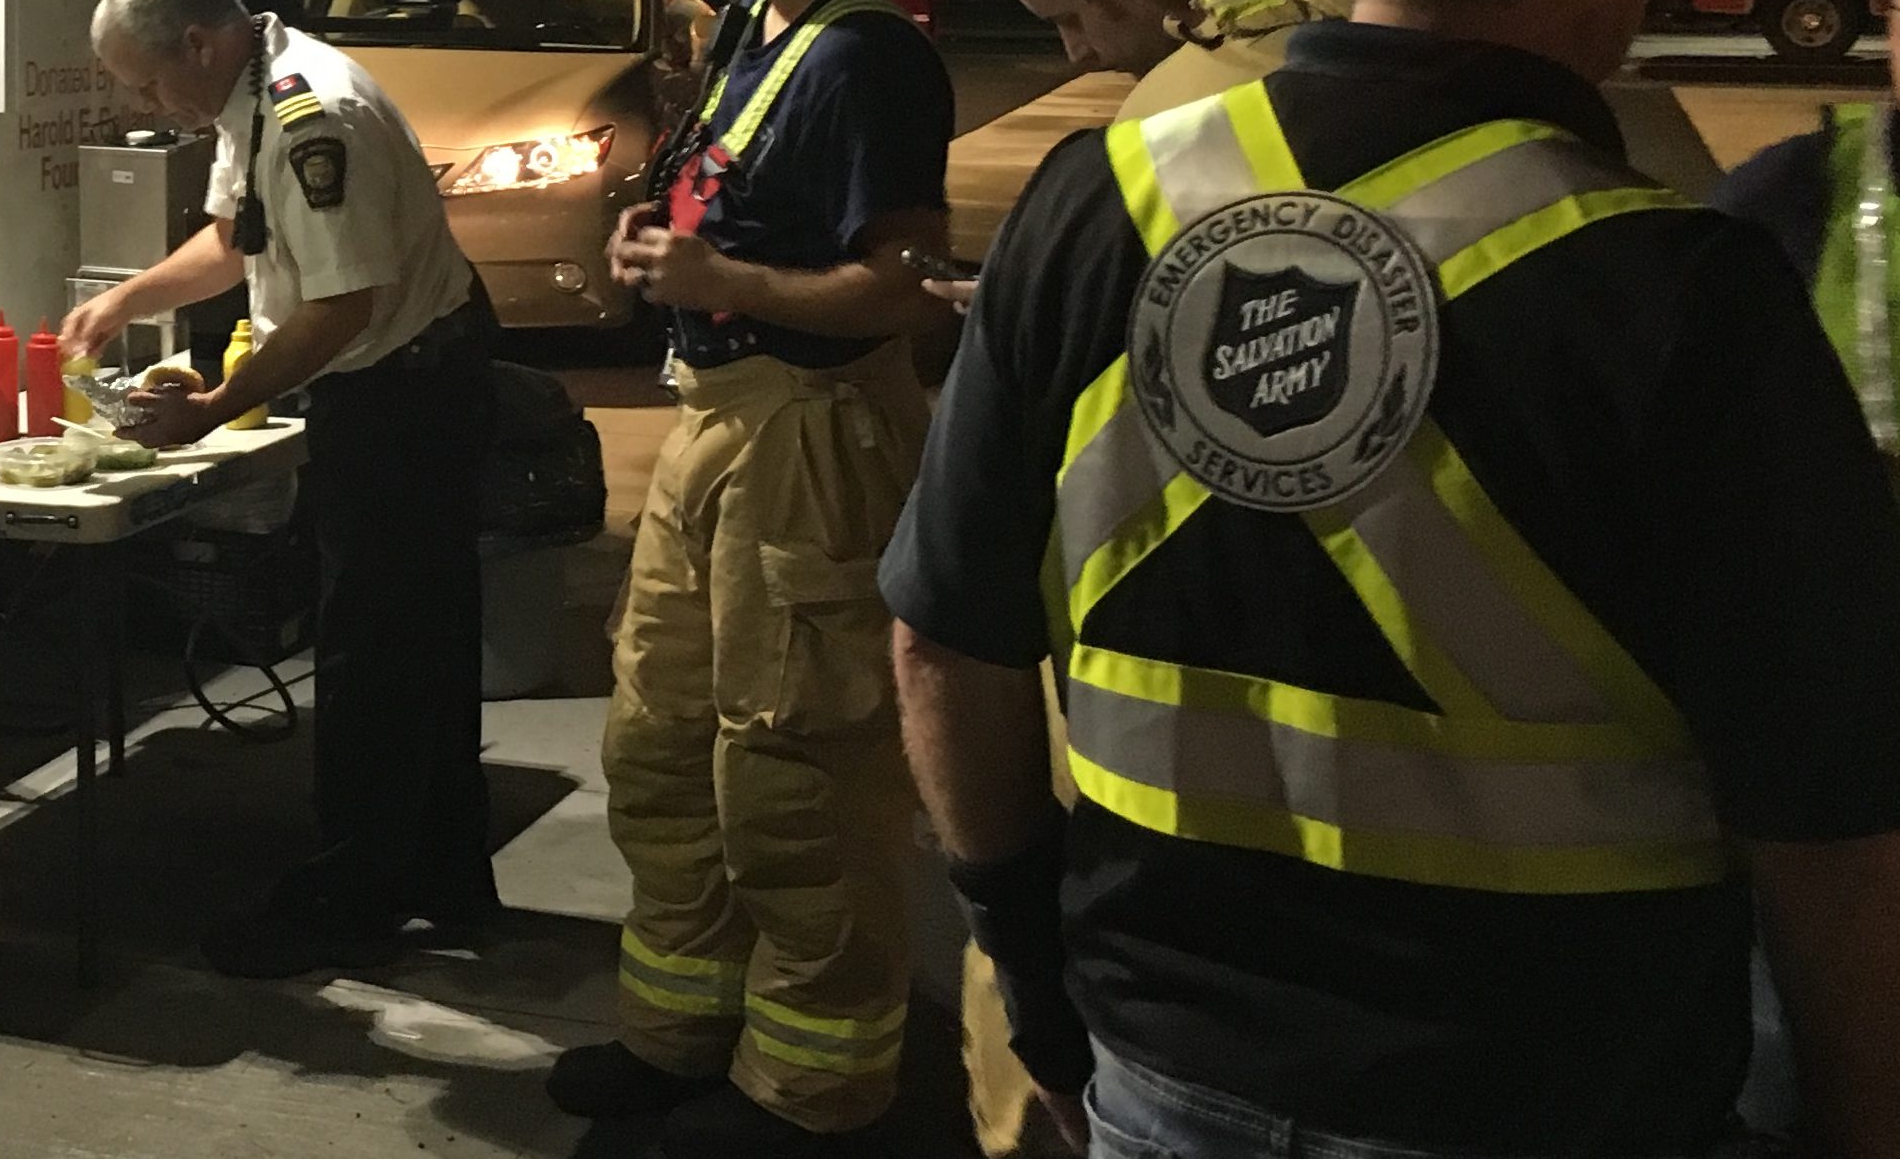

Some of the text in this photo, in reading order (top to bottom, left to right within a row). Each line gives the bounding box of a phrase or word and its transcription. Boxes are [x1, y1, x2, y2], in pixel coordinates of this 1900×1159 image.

[25, 58, 91, 97] Donated
[19, 109, 74, 150] Harold
[1149, 201, 1421, 336] EMERGENCY DISASTER
[1240, 289, 1300, 331] THE
[1212, 305, 1341, 381] SALVATION
[1249, 349, 1332, 409] ARMY
[1185, 441, 1334, 497] SERVICES
